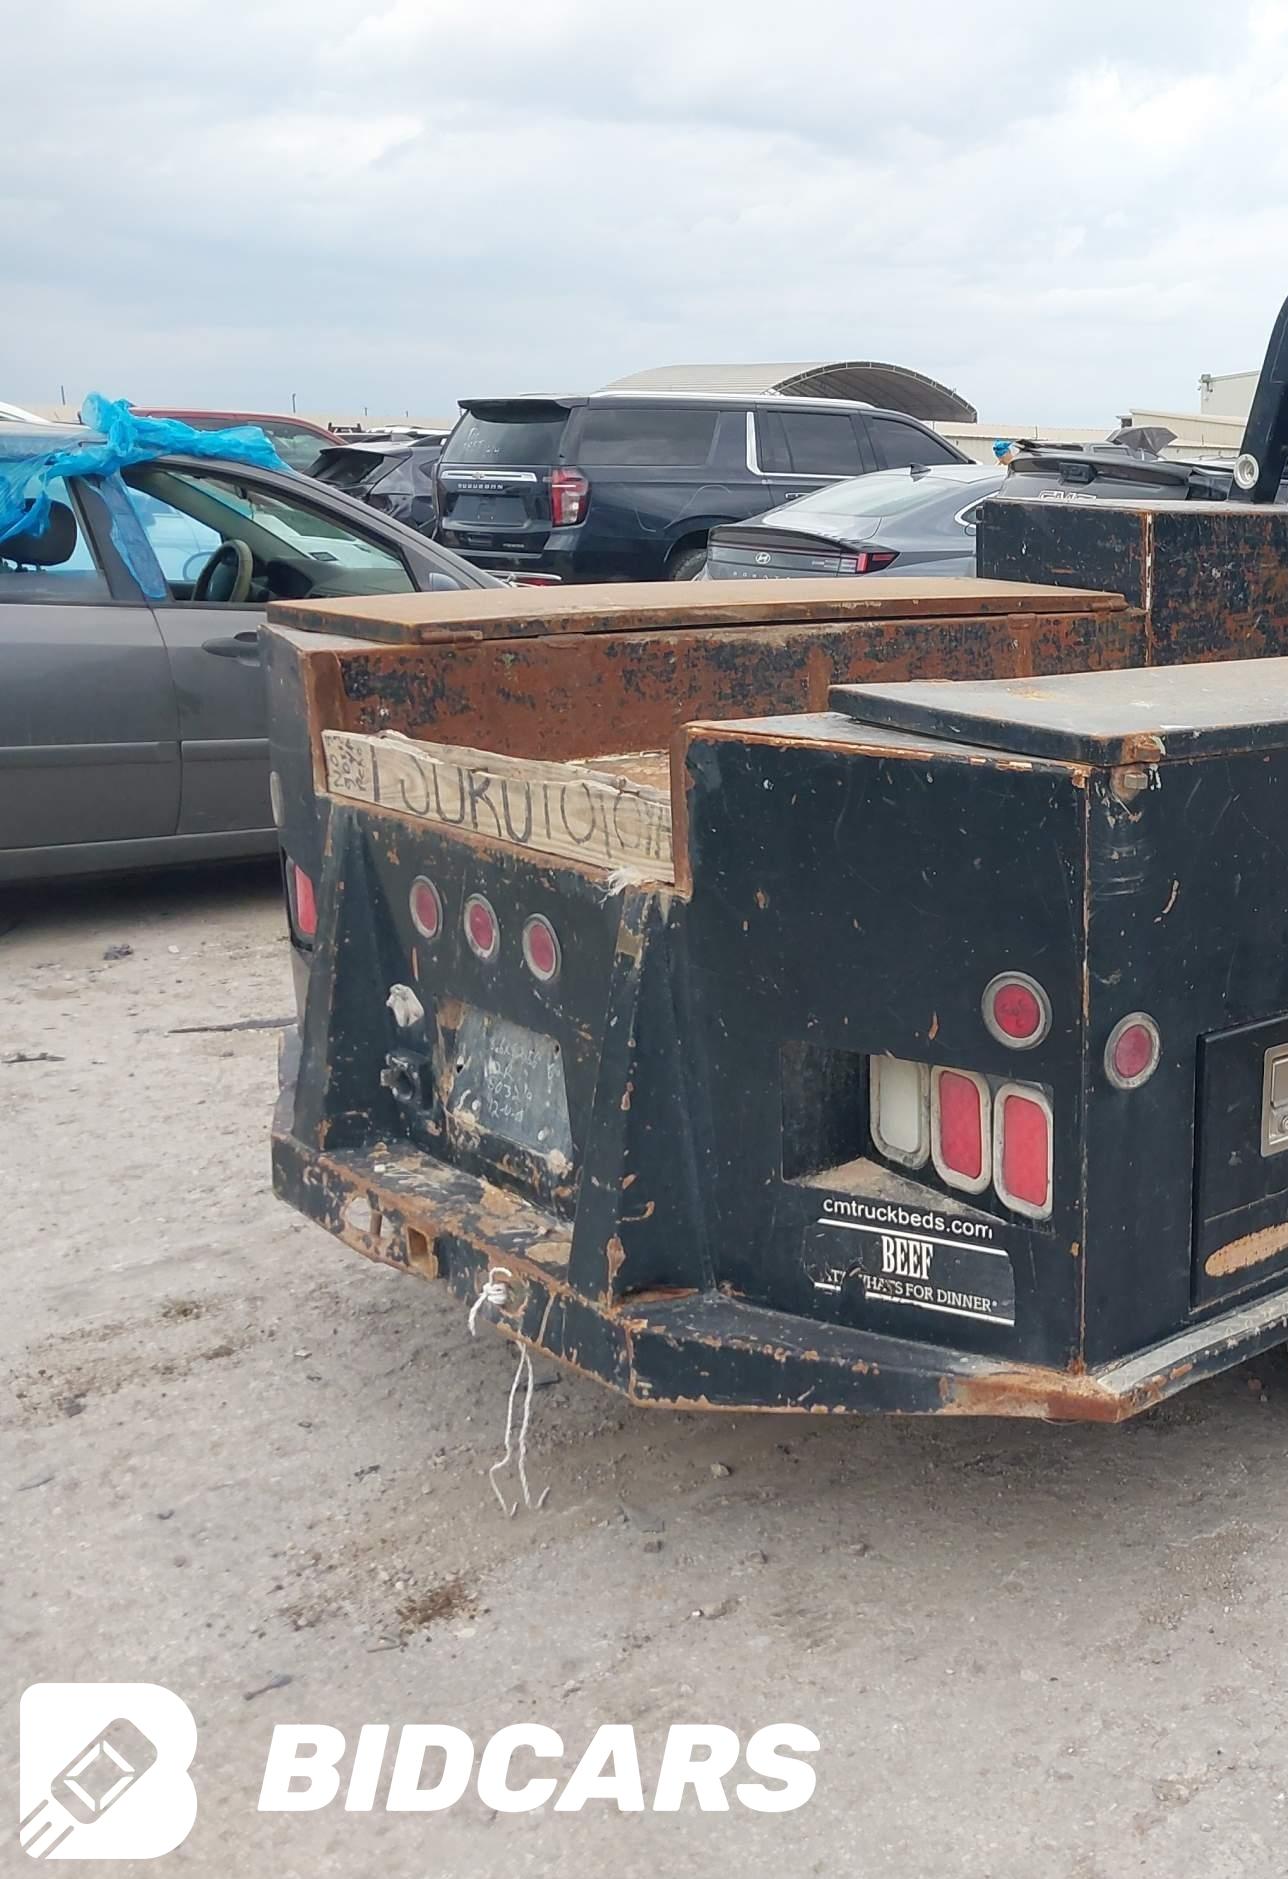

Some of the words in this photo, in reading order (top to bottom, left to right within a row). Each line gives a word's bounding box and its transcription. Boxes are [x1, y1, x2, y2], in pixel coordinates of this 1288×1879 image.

[822, 1198, 993, 1240] cmtruckbeds.com
[881, 1235, 934, 1280] BEEF
[906, 1283, 934, 1301] FOR
